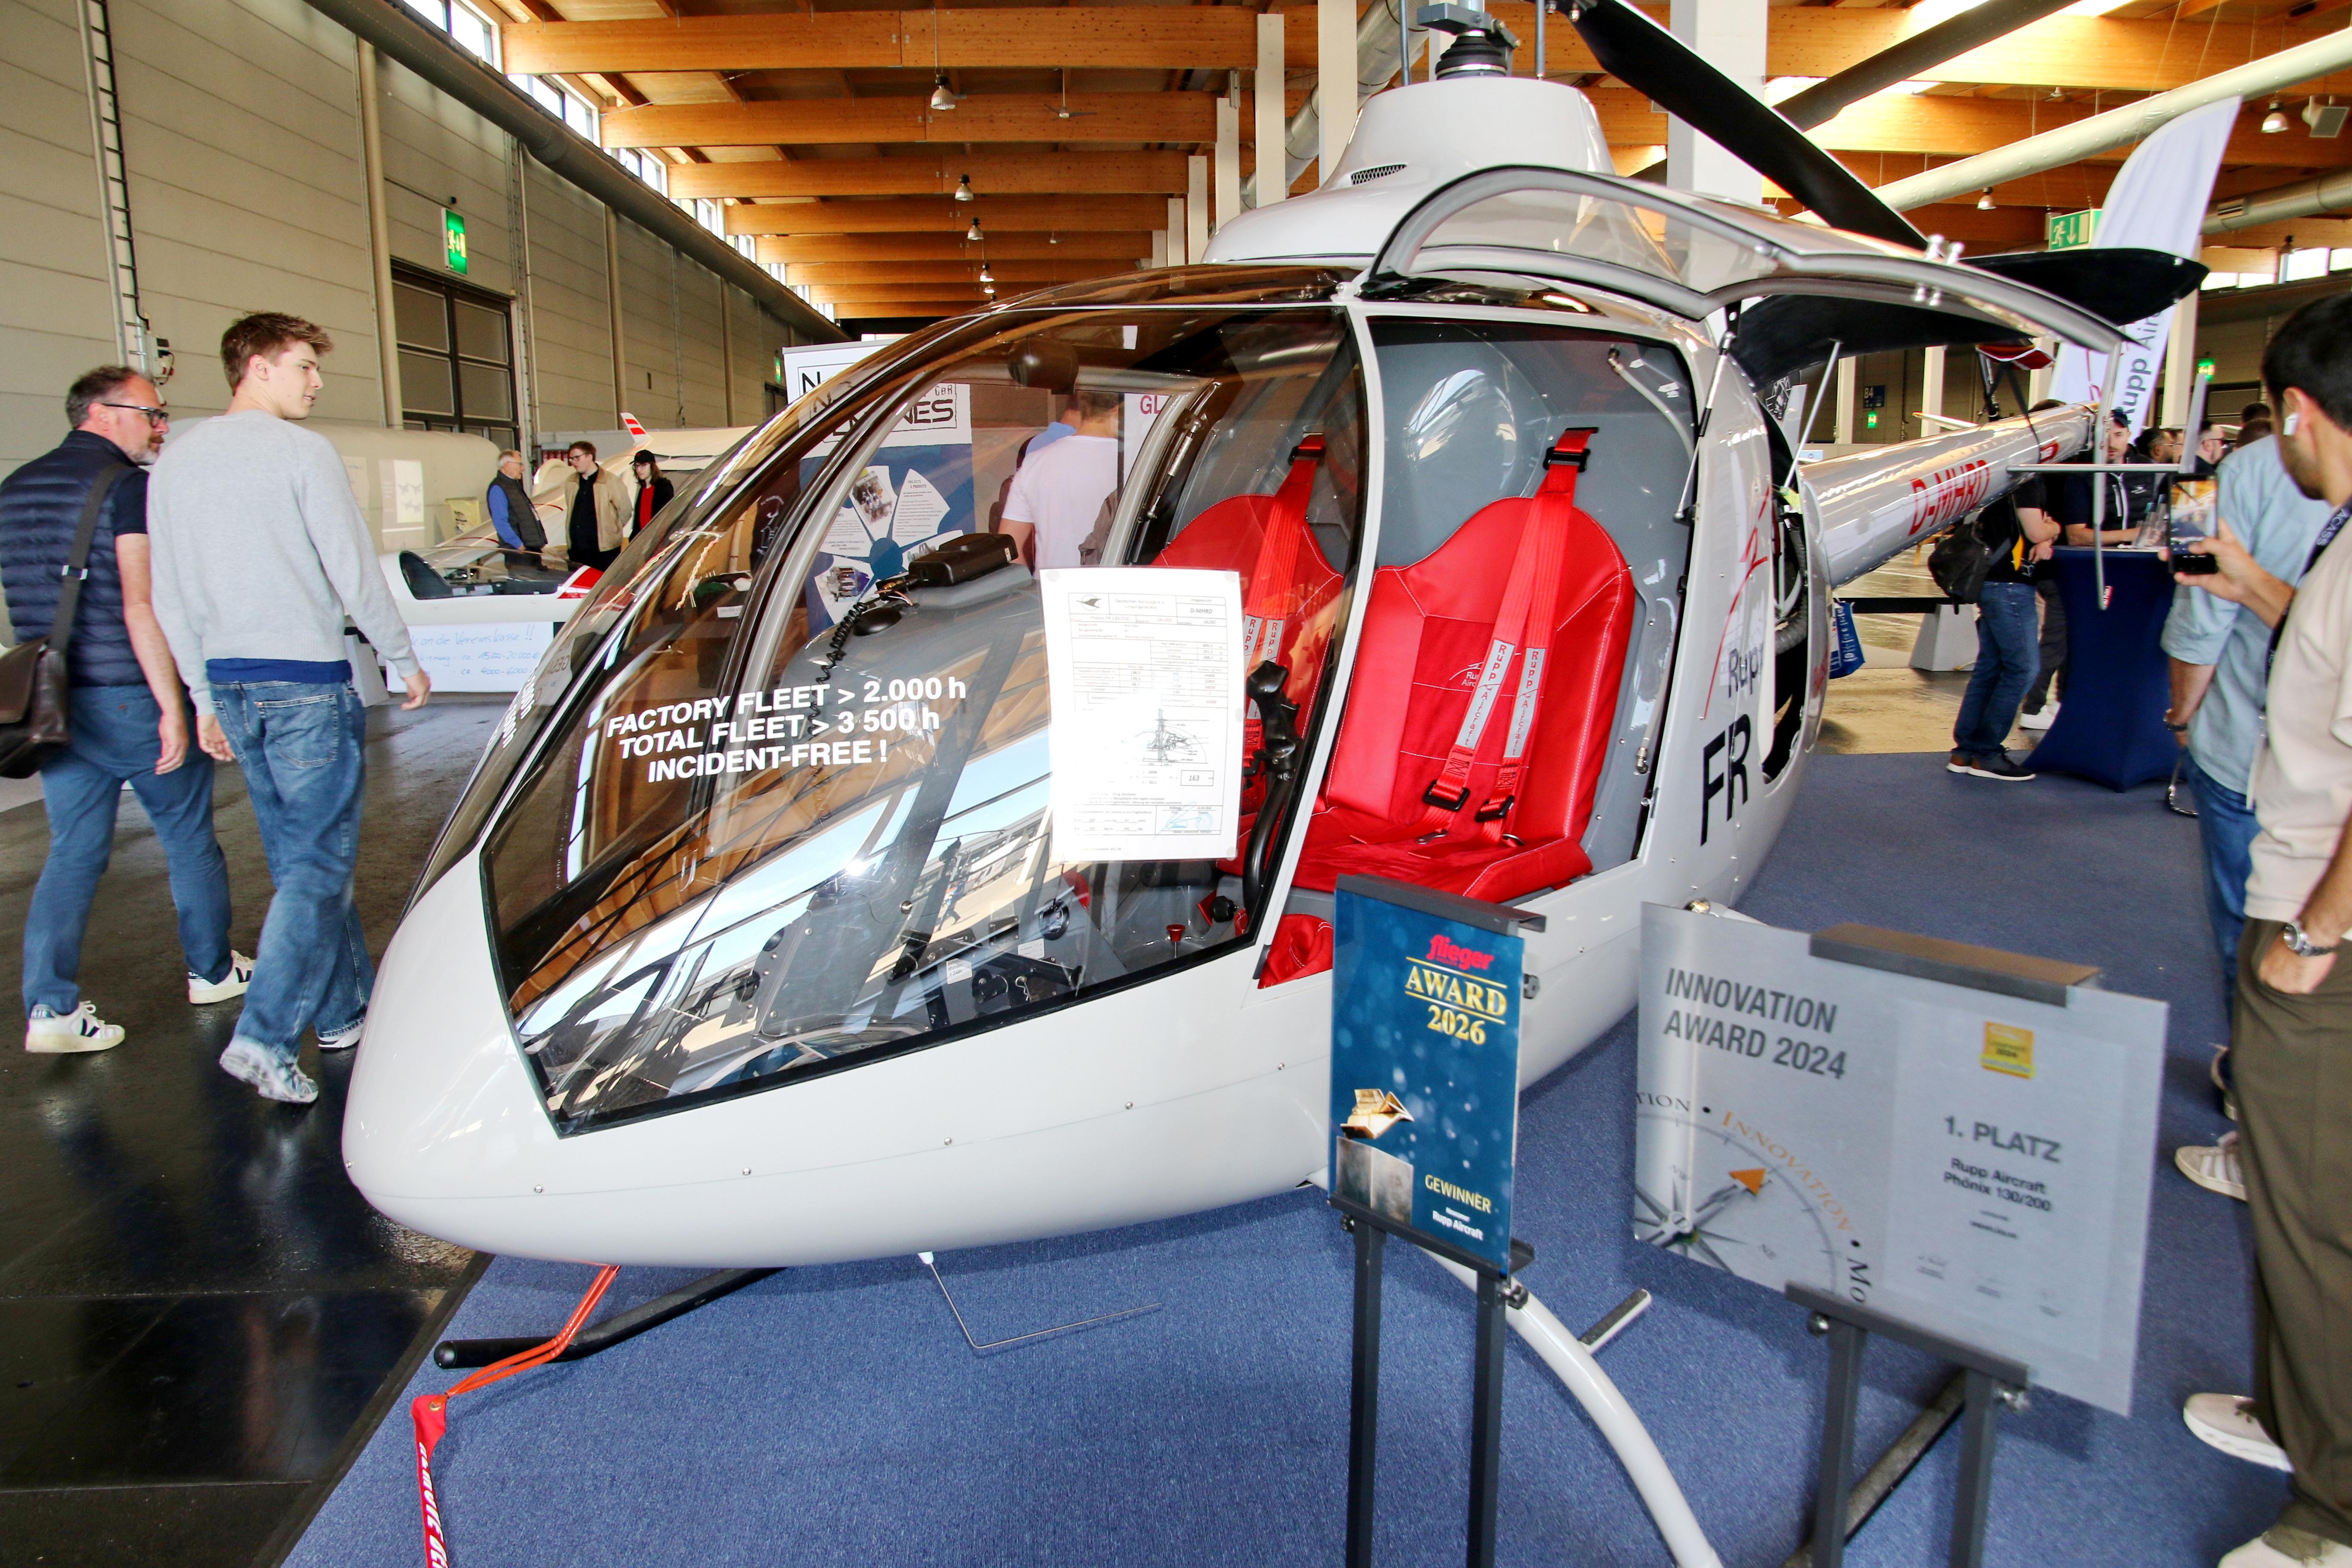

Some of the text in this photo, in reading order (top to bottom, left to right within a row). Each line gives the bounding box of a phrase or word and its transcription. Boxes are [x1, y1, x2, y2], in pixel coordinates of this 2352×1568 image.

[1864, 387, 1873, 398] B4
[1908, 459, 1990, 536] D-MHRD
[2317, 508, 2346, 546] ACASS
[1488, 644, 1507, 681] Rupp
[1526, 651, 1538, 689] Rupp
[1728, 642, 1764, 698] Rup
[607, 695, 730, 738] FACTORY
[738, 683, 830, 715] FLEET
[863, 677, 943, 703] 2.000
[948, 676, 967, 700] h
[1464, 692, 1488, 746] Aircraft
[1512, 700, 1528, 756] Aircraft
[619, 725, 704, 759] TOTAL
[712, 714, 804, 747] FLEET
[922, 707, 940, 730] h
[648, 740, 871, 783] INCIDENT-FREE
[1700, 714, 1751, 847] FR
[1426, 934, 1494, 970] flieger
[1405, 967, 1507, 1017] AWARD
[1666, 968, 1838, 1033] INNOVATION
[1427, 1005, 1485, 1045] 2026
[1663, 1010, 1848, 1080] AWARD 2024
[1944, 1115, 2062, 1163] 1. PLATZ
[1424, 1174, 1492, 1214] GEWINNER
[1943, 1170, 2052, 1212] Phönix 130/200
[1951, 1157, 2046, 1195] Rupp Aircraft
[1432, 1210, 1483, 1241] Rupp Aircraft
